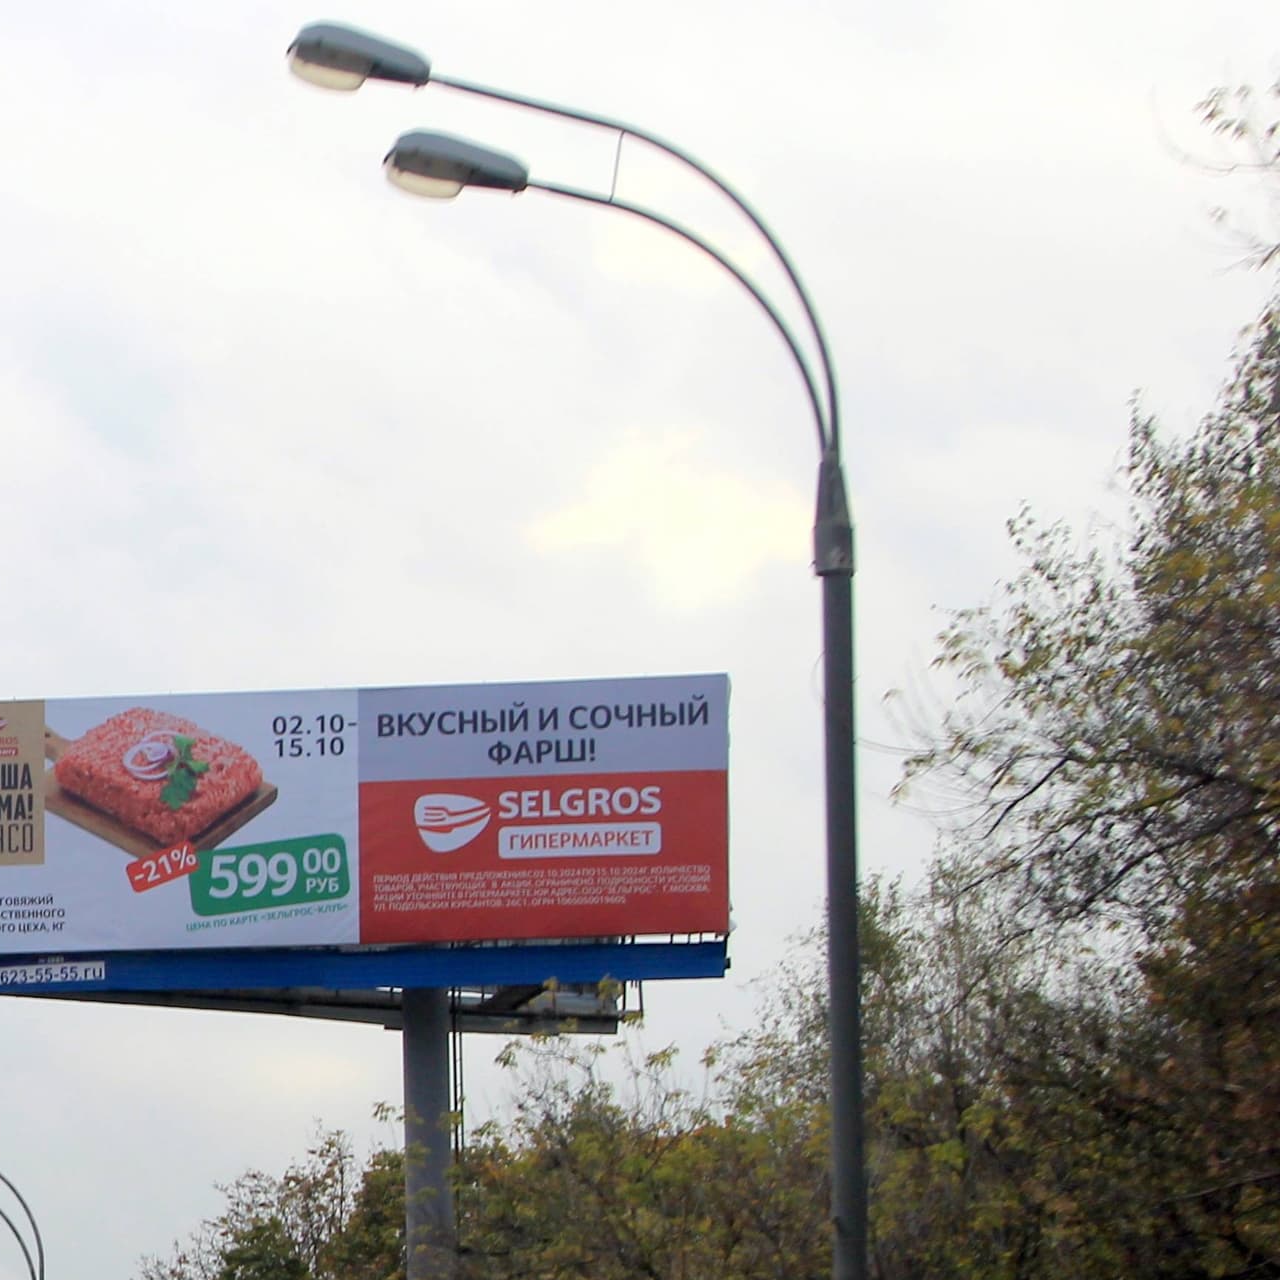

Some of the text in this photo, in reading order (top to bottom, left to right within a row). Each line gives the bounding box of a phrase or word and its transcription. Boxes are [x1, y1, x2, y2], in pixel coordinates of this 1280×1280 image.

[272, 714, 358, 735] 02.10-
[377, 694, 710, 737] ВКУСНЫЙ И СОЧНЫЙ
[274, 736, 345, 758] 15.10
[487, 738, 596, 765] ФАРШ!
[498, 786, 661, 820] SELGROS
[509, 829, 654, 850] ГИПЕРМАРКЕТ
[134, 845, 197, 883] -21%
[208, 848, 341, 899] 599 00
[305, 877, 340, 893] РУБ
[0, 894, 53, 906] ГОВЯЖИЙ
[18, 922, 49, 934] ЦЕХА,
[53, 922, 65, 931] КГ
[0, 966, 103, 985] 623-55-55.ru
